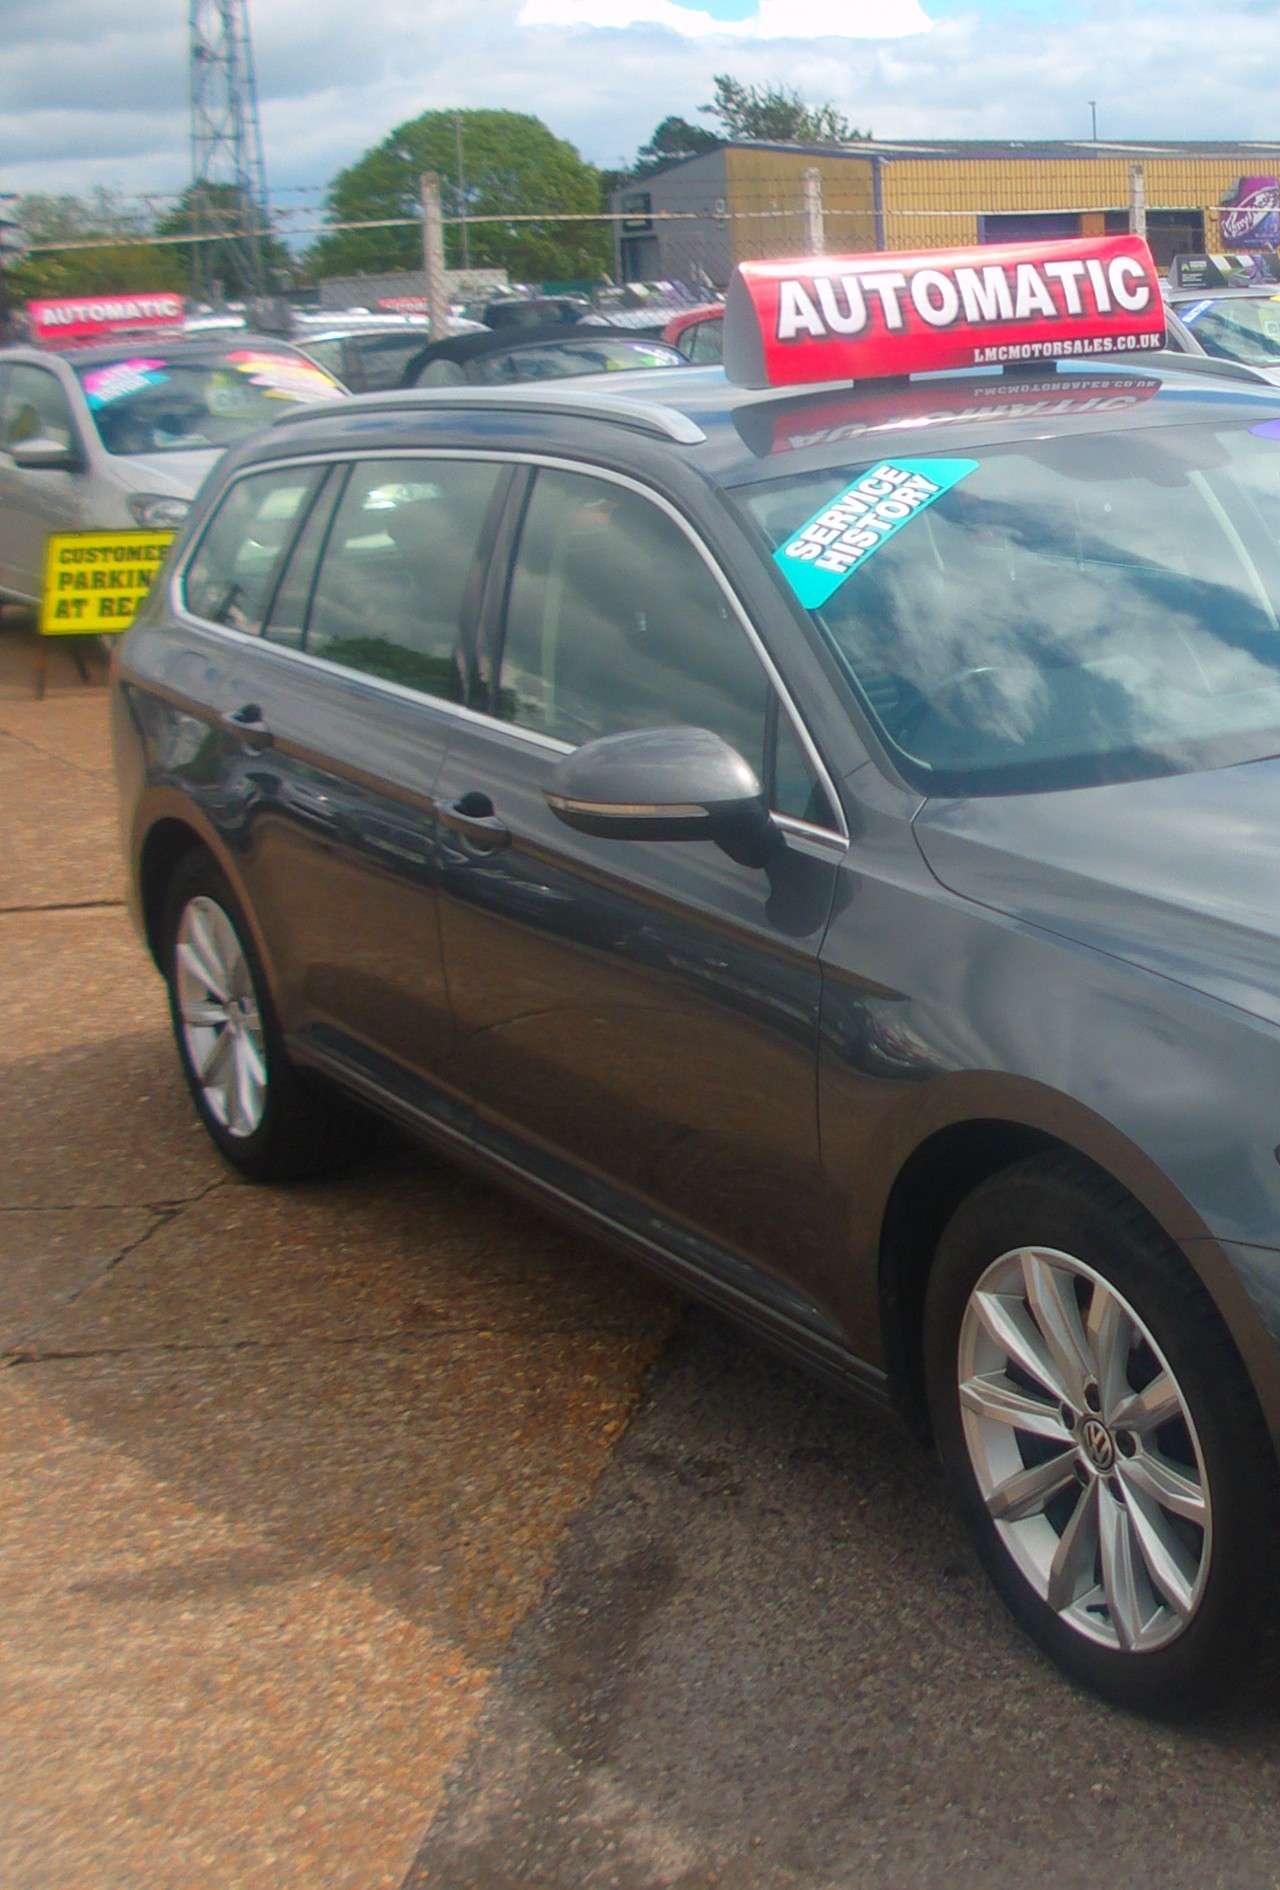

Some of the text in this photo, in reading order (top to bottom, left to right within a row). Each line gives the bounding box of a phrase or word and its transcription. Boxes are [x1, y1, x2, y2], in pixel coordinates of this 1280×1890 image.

[43, 299, 181, 325] AUTOMATIC
[777, 255, 1151, 340] AUTOMATIC
[974, 333, 1161, 363] LMCMOTORSALES.CO.UK
[784, 464, 912, 561] SERVICE
[814, 473, 943, 574] HISTORY
[58, 569, 152, 591] PARKIN
[54, 597, 142, 618] AT RE
